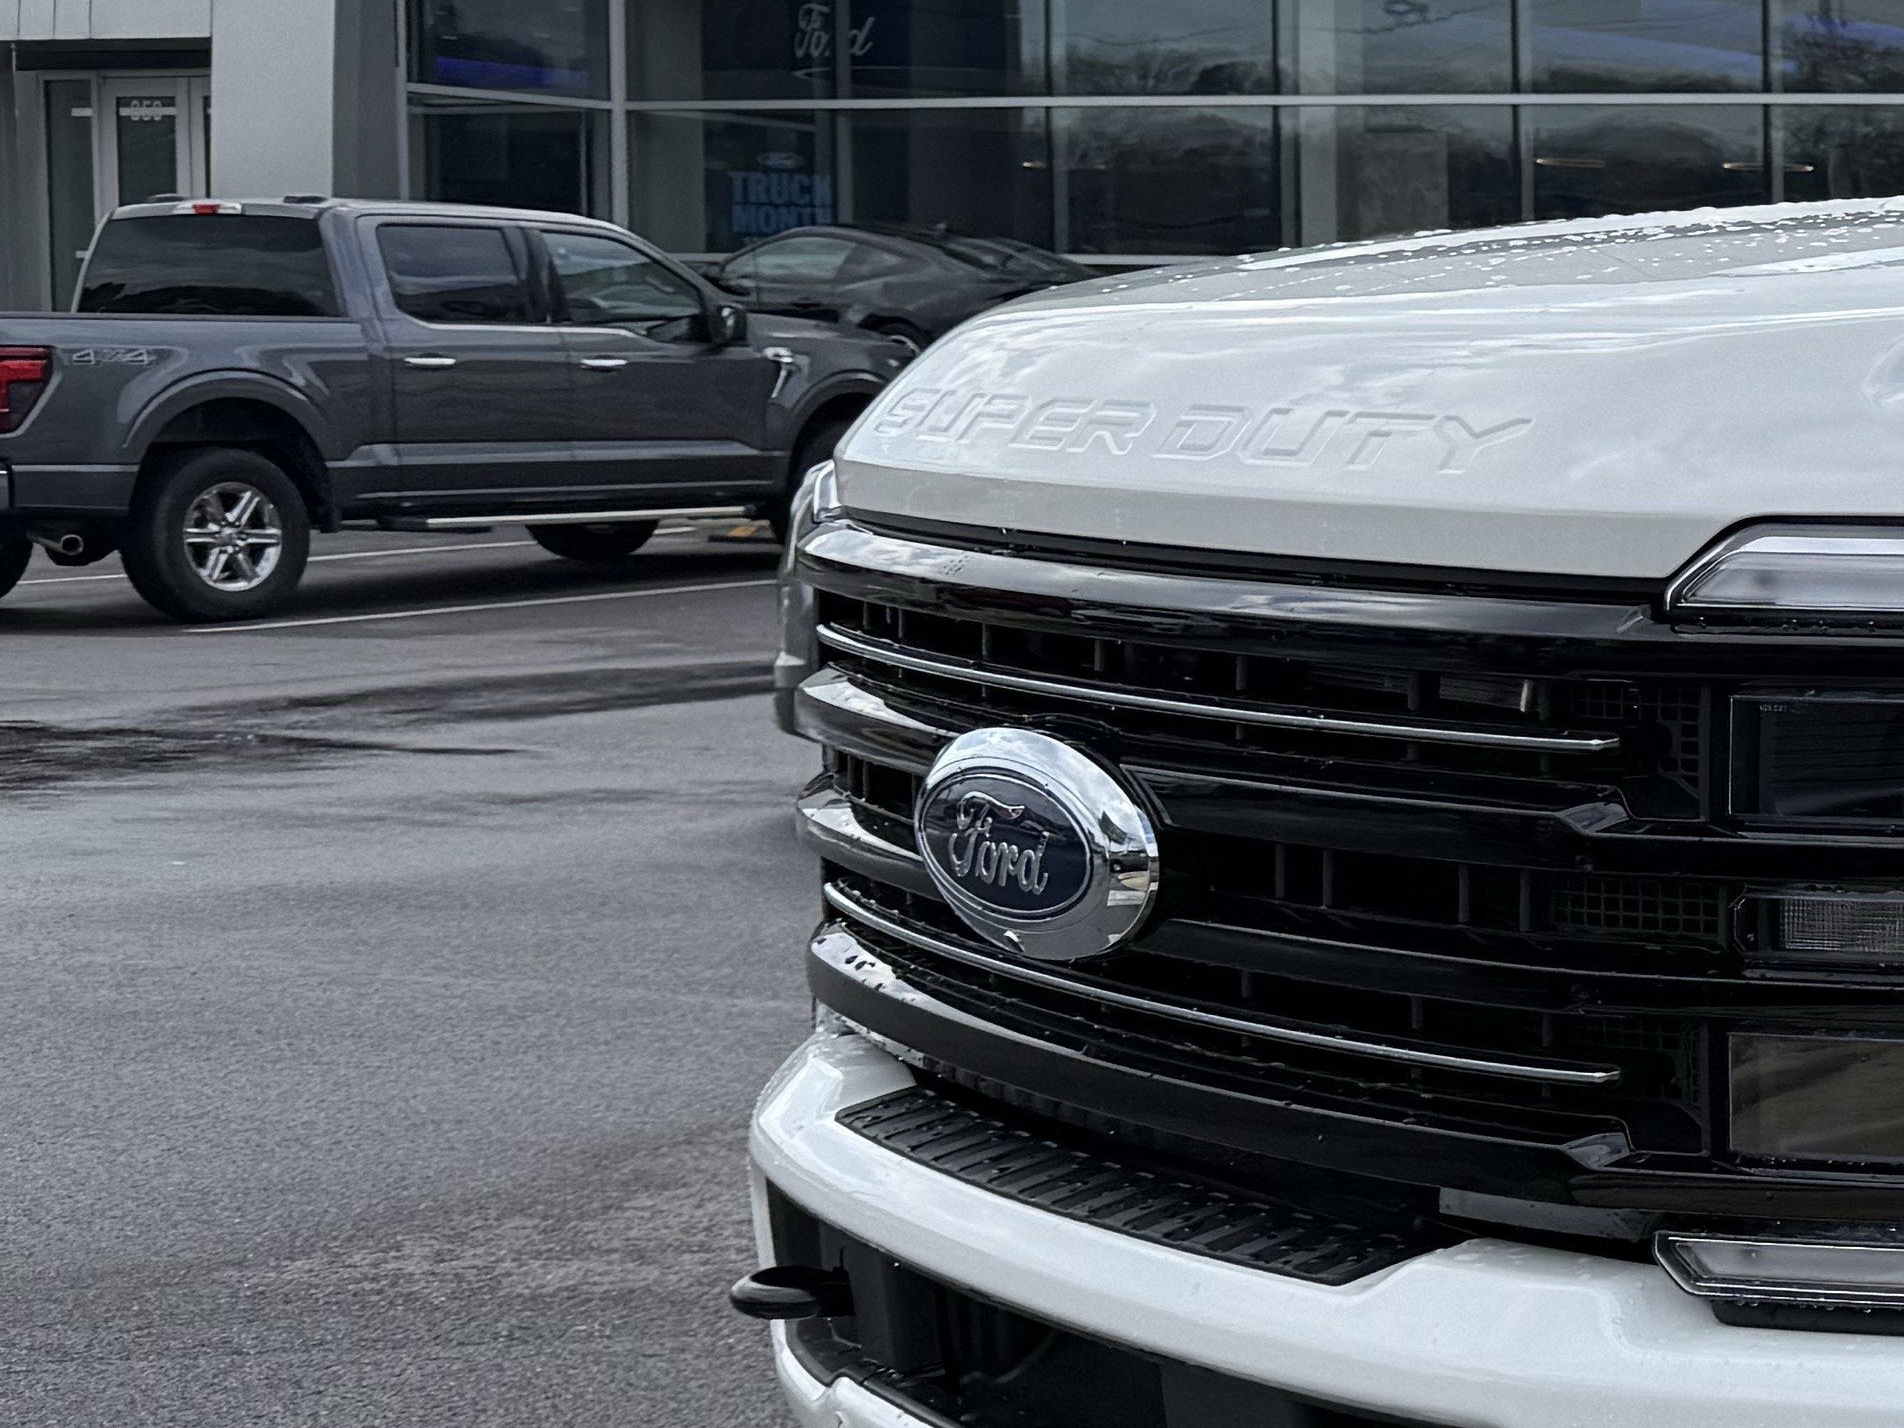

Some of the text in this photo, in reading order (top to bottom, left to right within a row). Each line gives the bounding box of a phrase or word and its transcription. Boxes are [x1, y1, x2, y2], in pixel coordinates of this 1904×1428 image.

[793, 3, 876, 58] Fod
[728, 171, 832, 206] TRUCK
[873, 387, 1536, 474] SUPER DUTY
[948, 790, 1050, 896] Ford
